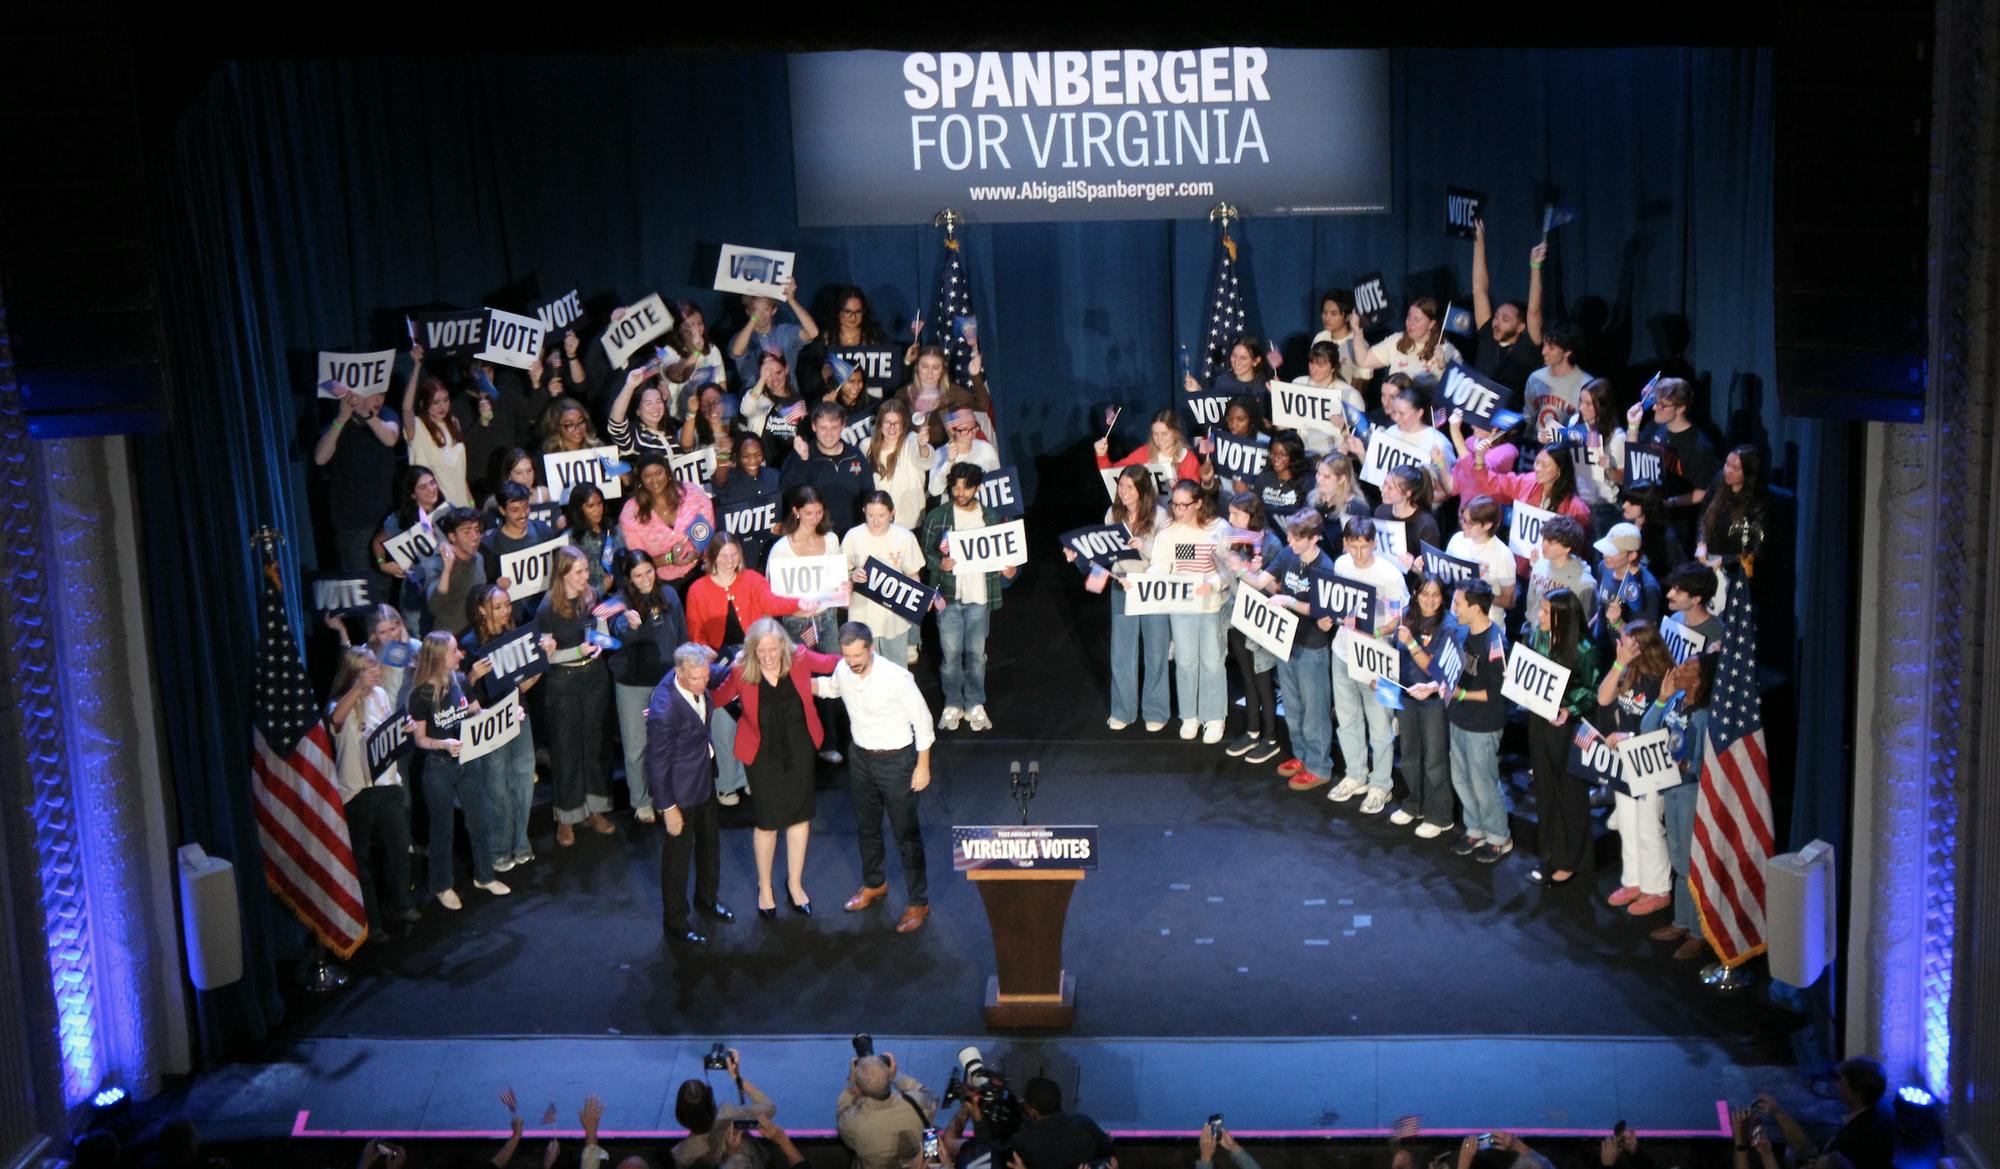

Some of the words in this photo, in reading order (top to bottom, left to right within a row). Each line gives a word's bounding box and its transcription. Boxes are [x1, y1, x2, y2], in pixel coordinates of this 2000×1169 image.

[903, 46, 1270, 110] SPANBERGER
[912, 113, 1010, 171] FOR
[1022, 108, 1270, 169] VIRGINIA
[970, 178, 1213, 203] www.AbigailSpanberger.com
[1448, 195, 1478, 227] VOTE
[538, 289, 583, 333] VOTE
[1354, 278, 1388, 315] VOTE
[427, 318, 483, 348] VOTE
[490, 318, 538, 356] VOTE
[609, 306, 661, 344] VOTE
[330, 359, 385, 388] VOTE
[1188, 396, 1232, 424] VOT
[1281, 390, 1331, 421] VOTE
[1444, 370, 1500, 418] VOTE
[674, 458, 710, 485] OTE
[1216, 437, 1269, 476] VOTE
[1631, 451, 1661, 482] VOTE
[975, 476, 1014, 508] OTE
[725, 503, 776, 535] VOTE
[1520, 513, 1545, 544] VO
[398, 534, 434, 565] VO
[960, 531, 1017, 561] VOTE
[1072, 529, 1127, 560] VOTE
[512, 552, 551, 585] VOT
[781, 565, 824, 594] VOT
[313, 579, 370, 611] VOTE
[867, 566, 924, 612] VOTE
[1138, 580, 1194, 602] VOTE
[1318, 577, 1369, 620] VOTE
[1244, 594, 1288, 643] VOTE
[488, 631, 540, 680] VOTE
[1354, 642, 1394, 678] VOTE
[1514, 664, 1559, 703] VOTE
[471, 703, 513, 746] VOTE
[370, 717, 408, 769] VOTE
[1581, 741, 1620, 778] VOT
[1628, 741, 1672, 778] VOTE
[962, 838, 1039, 860] VIRGINIA
[1040, 838, 1091, 860] VOTES
